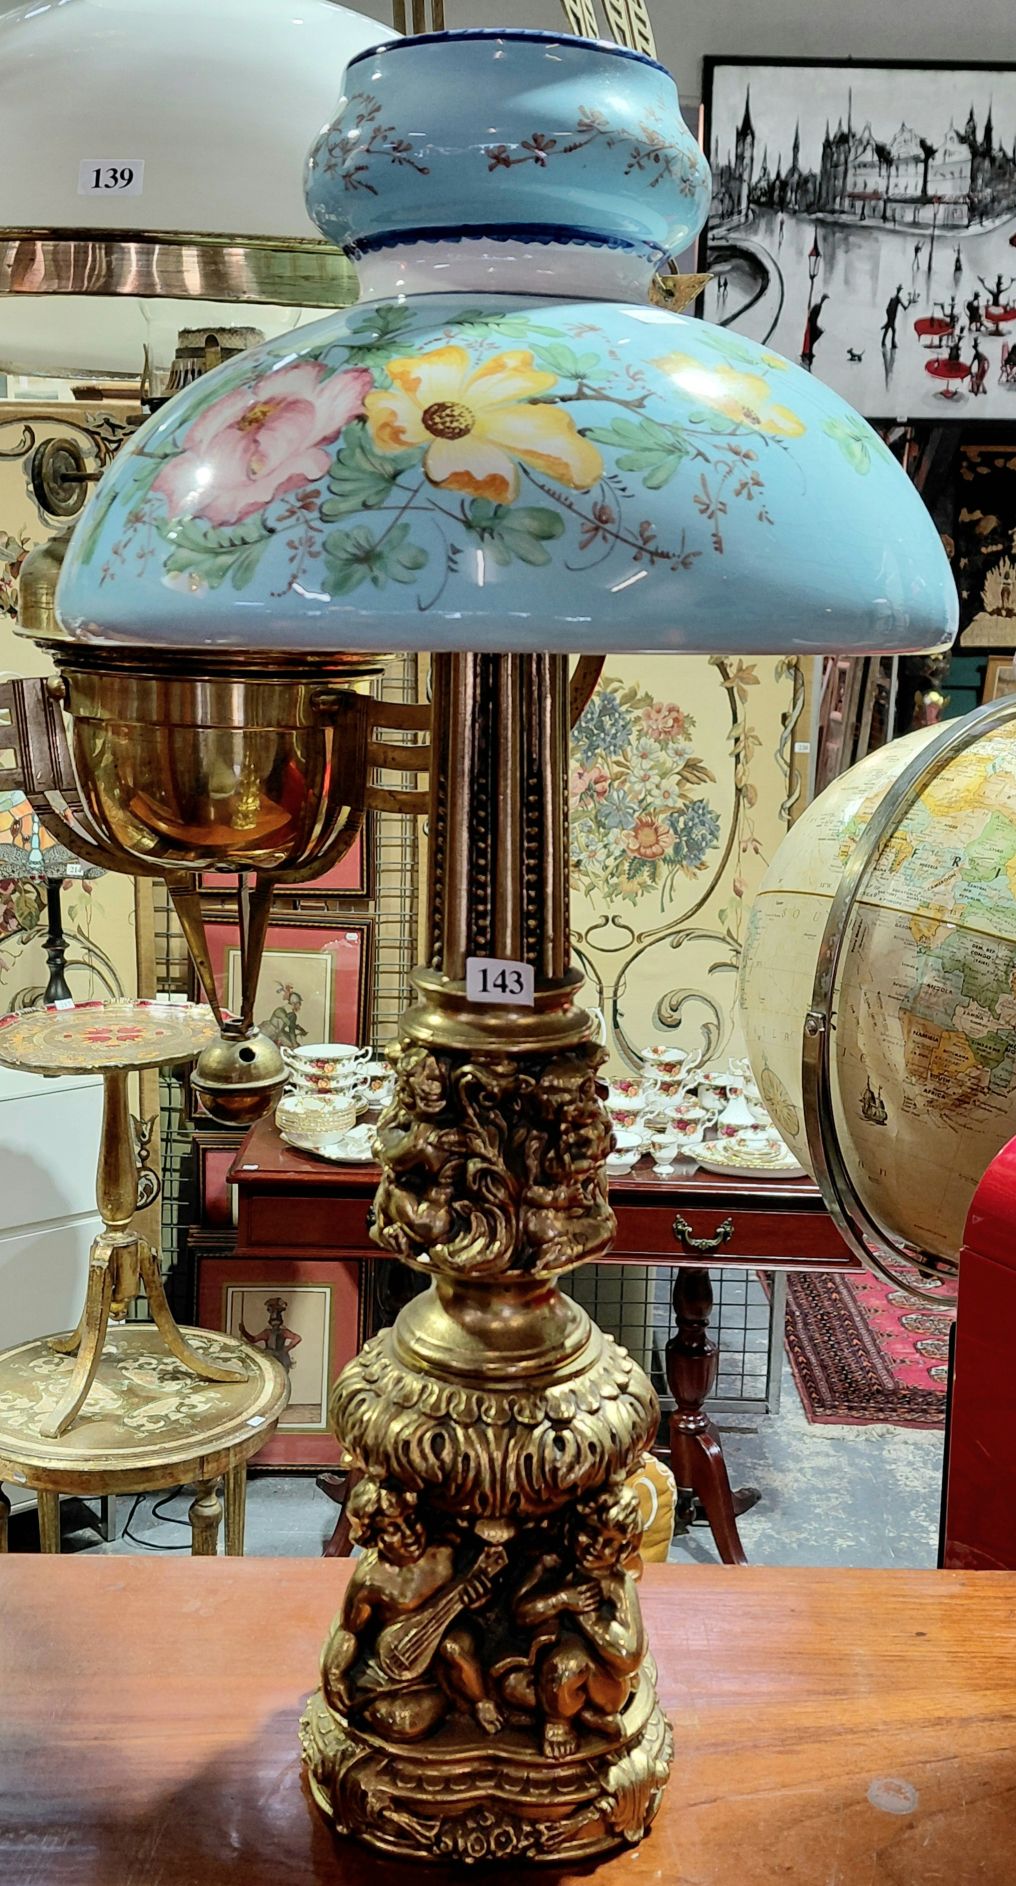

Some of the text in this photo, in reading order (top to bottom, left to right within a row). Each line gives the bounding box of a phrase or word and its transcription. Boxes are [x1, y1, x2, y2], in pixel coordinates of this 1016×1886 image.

[91, 167, 134, 189] 139
[478, 968, 524, 994] 143
[912, 1030, 939, 1042] NAMIBIA
[923, 1088, 946, 1099] AFRICA
